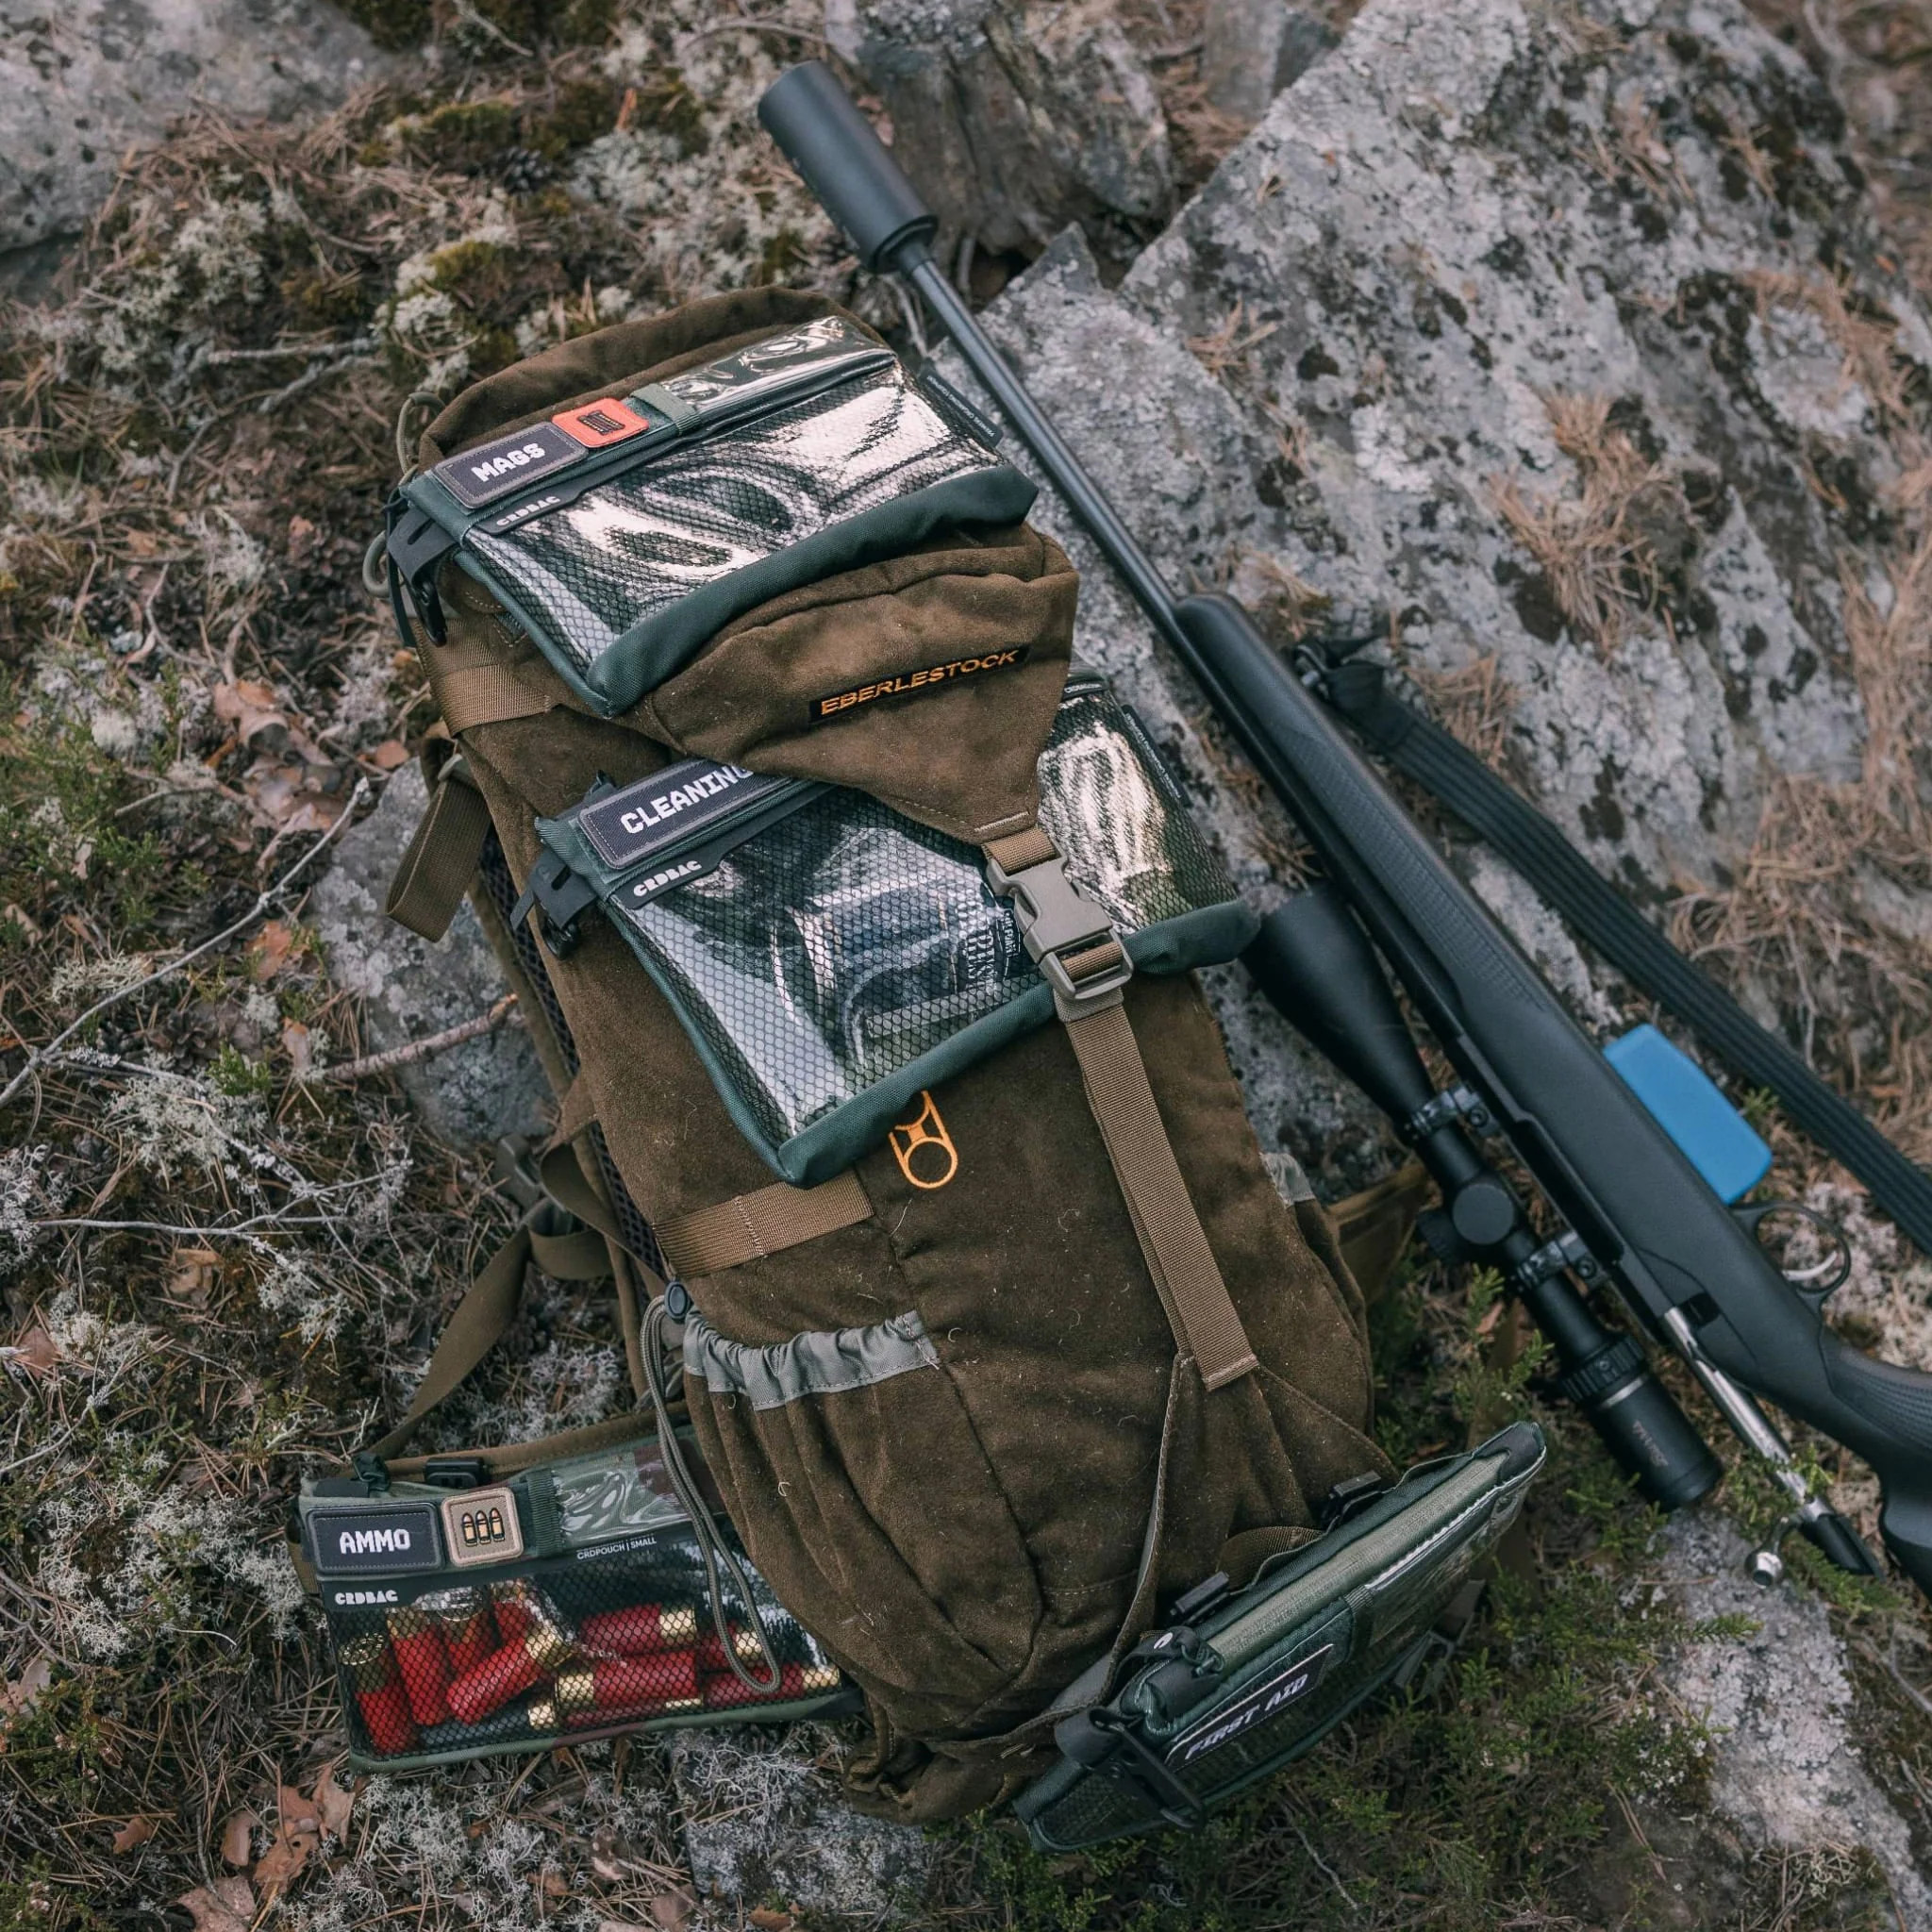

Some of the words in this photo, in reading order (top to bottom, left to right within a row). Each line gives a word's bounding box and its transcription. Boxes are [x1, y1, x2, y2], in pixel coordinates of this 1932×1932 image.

[471, 442, 546, 483] MAGS
[821, 649, 1020, 715] EBERLESTOCK
[339, 1527, 411, 1555] AMMO
[576, 1543, 625, 1560] CRDPOUCH
[630, 1537, 658, 1549] SMALL
[1184, 1705, 1261, 1760] FIRST
[1264, 1673, 1309, 1711] AID
